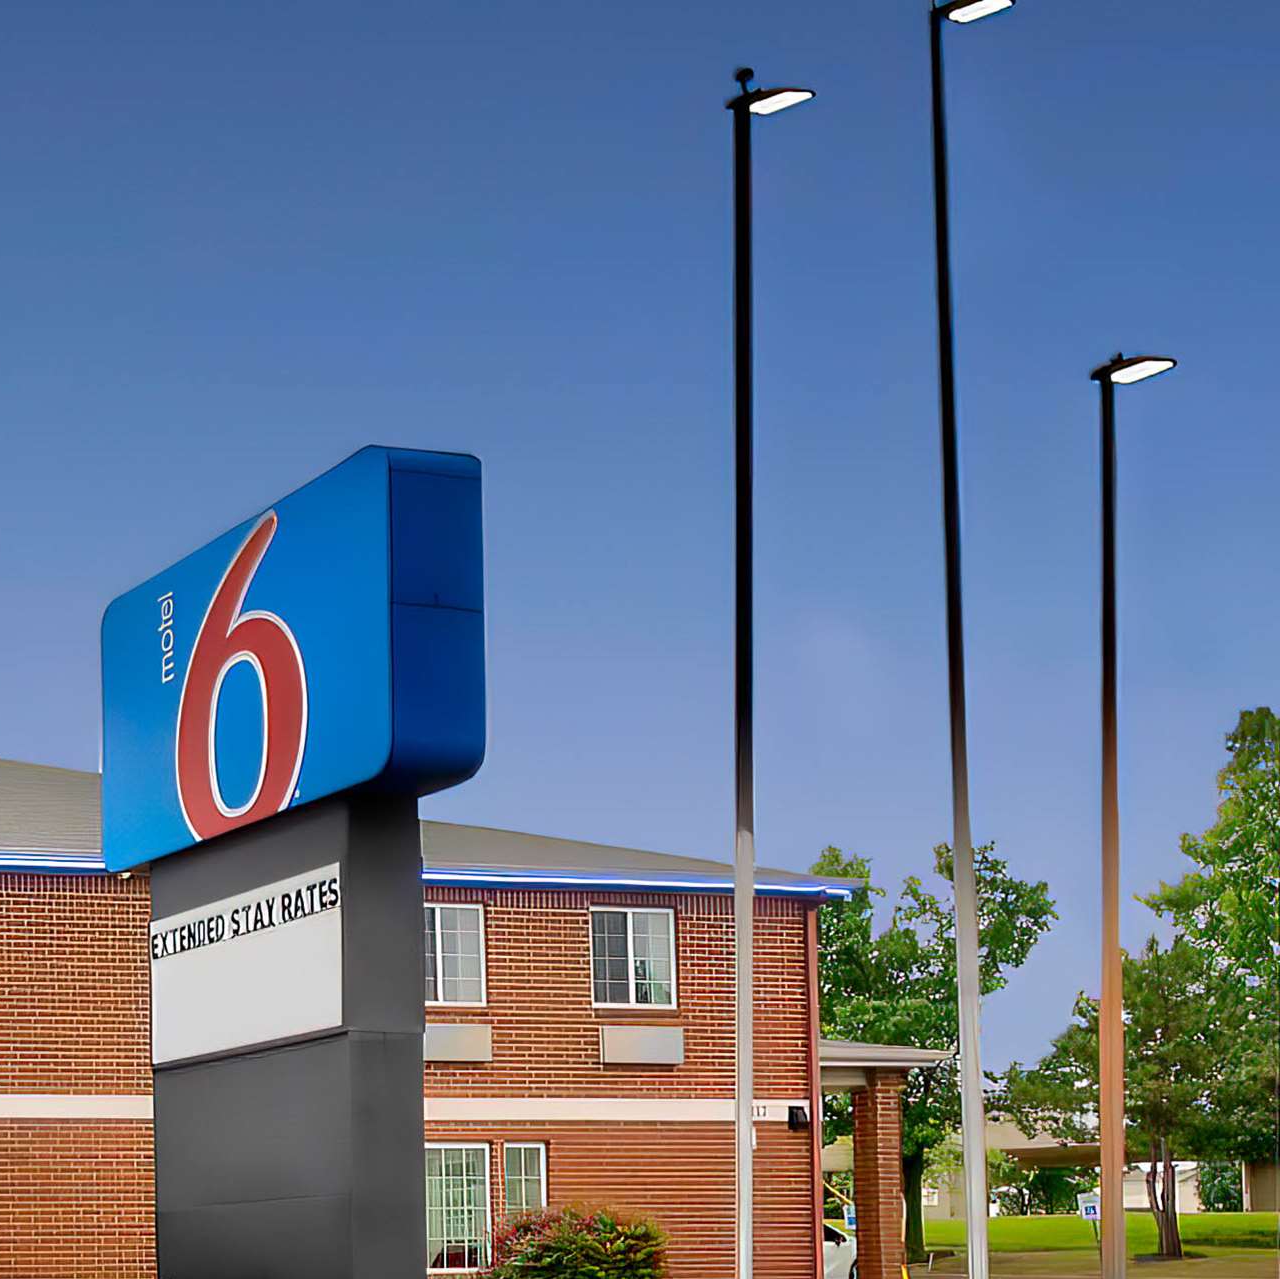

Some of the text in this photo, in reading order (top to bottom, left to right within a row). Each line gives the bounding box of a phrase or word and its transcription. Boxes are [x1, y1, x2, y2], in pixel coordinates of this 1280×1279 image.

[157, 591, 175, 684] motel
[175, 508, 308, 842] 6
[151, 877, 339, 960] EXTENDED STAY RATES
